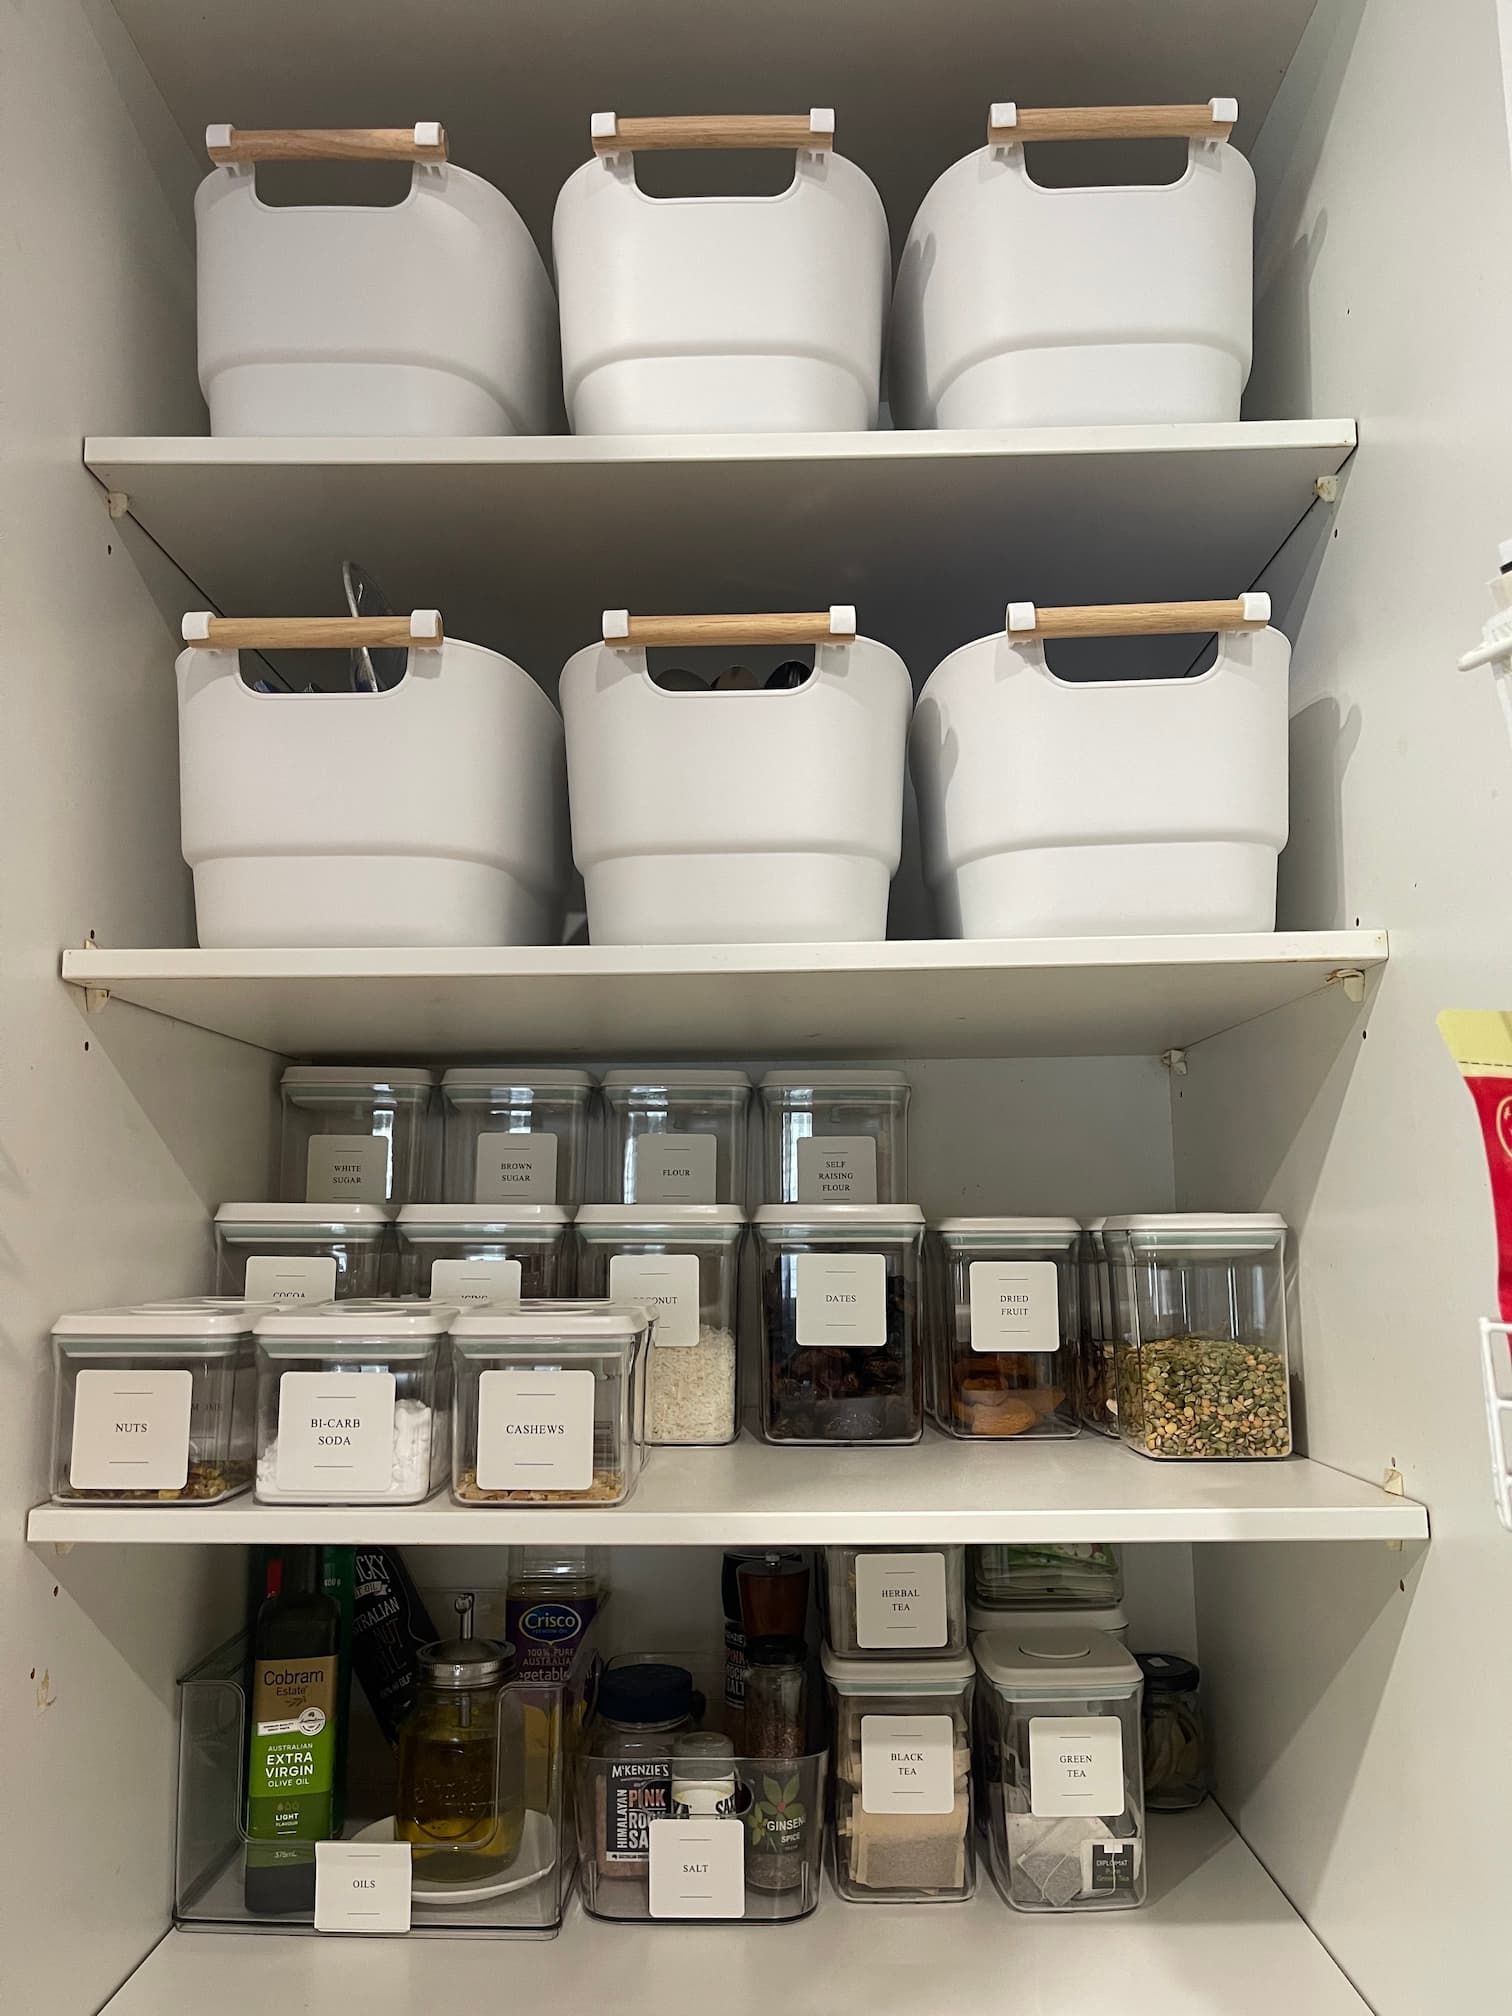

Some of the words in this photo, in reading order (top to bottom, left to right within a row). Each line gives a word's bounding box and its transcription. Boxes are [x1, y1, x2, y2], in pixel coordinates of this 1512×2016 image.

[663, 1169, 690, 1177] FLOUR
[818, 1172, 853, 1180] RAISING
[825, 1294, 857, 1303] DATES
[1000, 1294, 1029, 1303] DRIED
[1001, 1307, 1028, 1316] FRUIT
[114, 1422, 148, 1434] NUTS
[310, 1418, 361, 1429] BI-CARB
[506, 1424, 565, 1435] CASHEWS
[318, 1436, 352, 1447] SODA
[881, 1588, 920, 1598] HERBAL
[891, 1603, 911, 1612] TEA
[524, 1612, 577, 1629] Crisco
[264, 1669, 324, 1686] Cobram
[277, 1687, 307, 1697] Estate
[268, 1743, 313, 1752] AUSTRALIAN
[267, 1752, 313, 1765] EXTRA
[890, 1753, 924, 1762] BLACK
[1059, 1755, 1093, 1764] GREEN
[265, 1764, 314, 1778] VIRGIN
[897, 1767, 917, 1776] TEA
[1067, 1769, 1087, 1778] TEA
[268, 1779, 293, 1788] OLIVE
[296, 1778, 310, 1786] OIL
[628, 1789, 666, 1807] PINK
[275, 1812, 299, 1821] LIGHT
[616, 1789, 628, 1848] HIMALAYAN
[781, 1832, 800, 1843] SPICE
[683, 1865, 708, 1873] SALT
[352, 1880, 376, 1889] OILS
